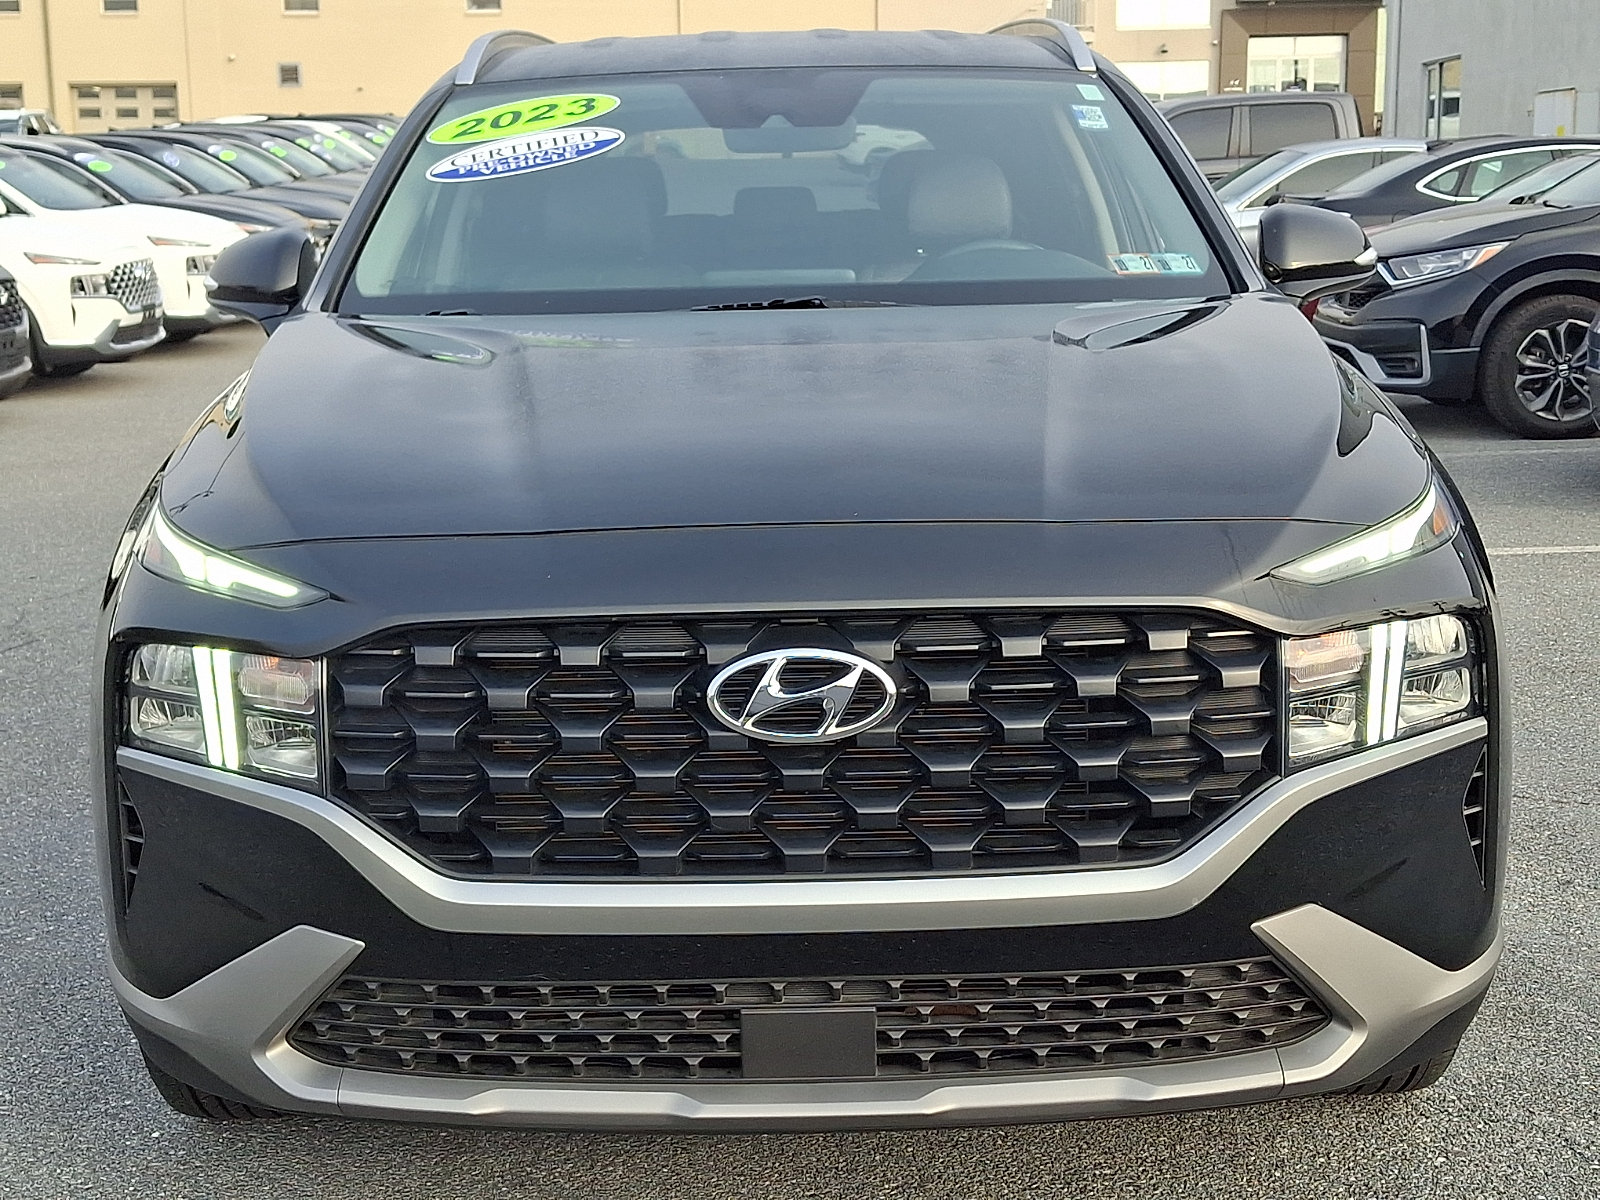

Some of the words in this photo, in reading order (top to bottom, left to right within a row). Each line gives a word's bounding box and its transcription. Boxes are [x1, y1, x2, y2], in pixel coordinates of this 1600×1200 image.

[450, 97, 597, 139] 2023
[450, 130, 600, 166] CERTIFIED
[479, 149, 579, 175] VEHICLE
